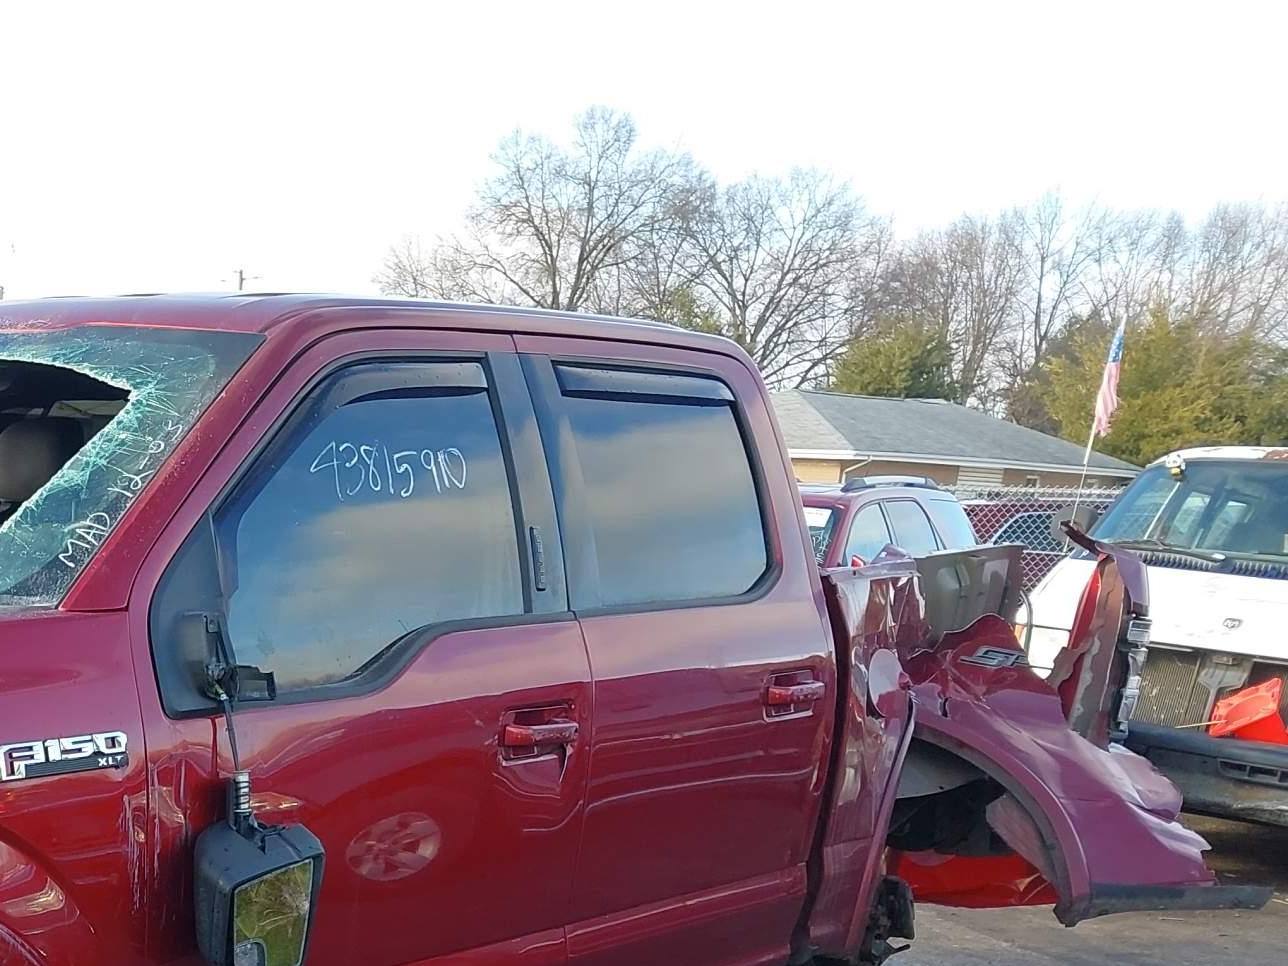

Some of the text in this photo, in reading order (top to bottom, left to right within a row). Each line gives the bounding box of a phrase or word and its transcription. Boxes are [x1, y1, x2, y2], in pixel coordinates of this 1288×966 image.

[309, 440, 467, 501] 43815910
[58, 511, 111, 568] MAD
[98, 755, 125, 767] XLT
